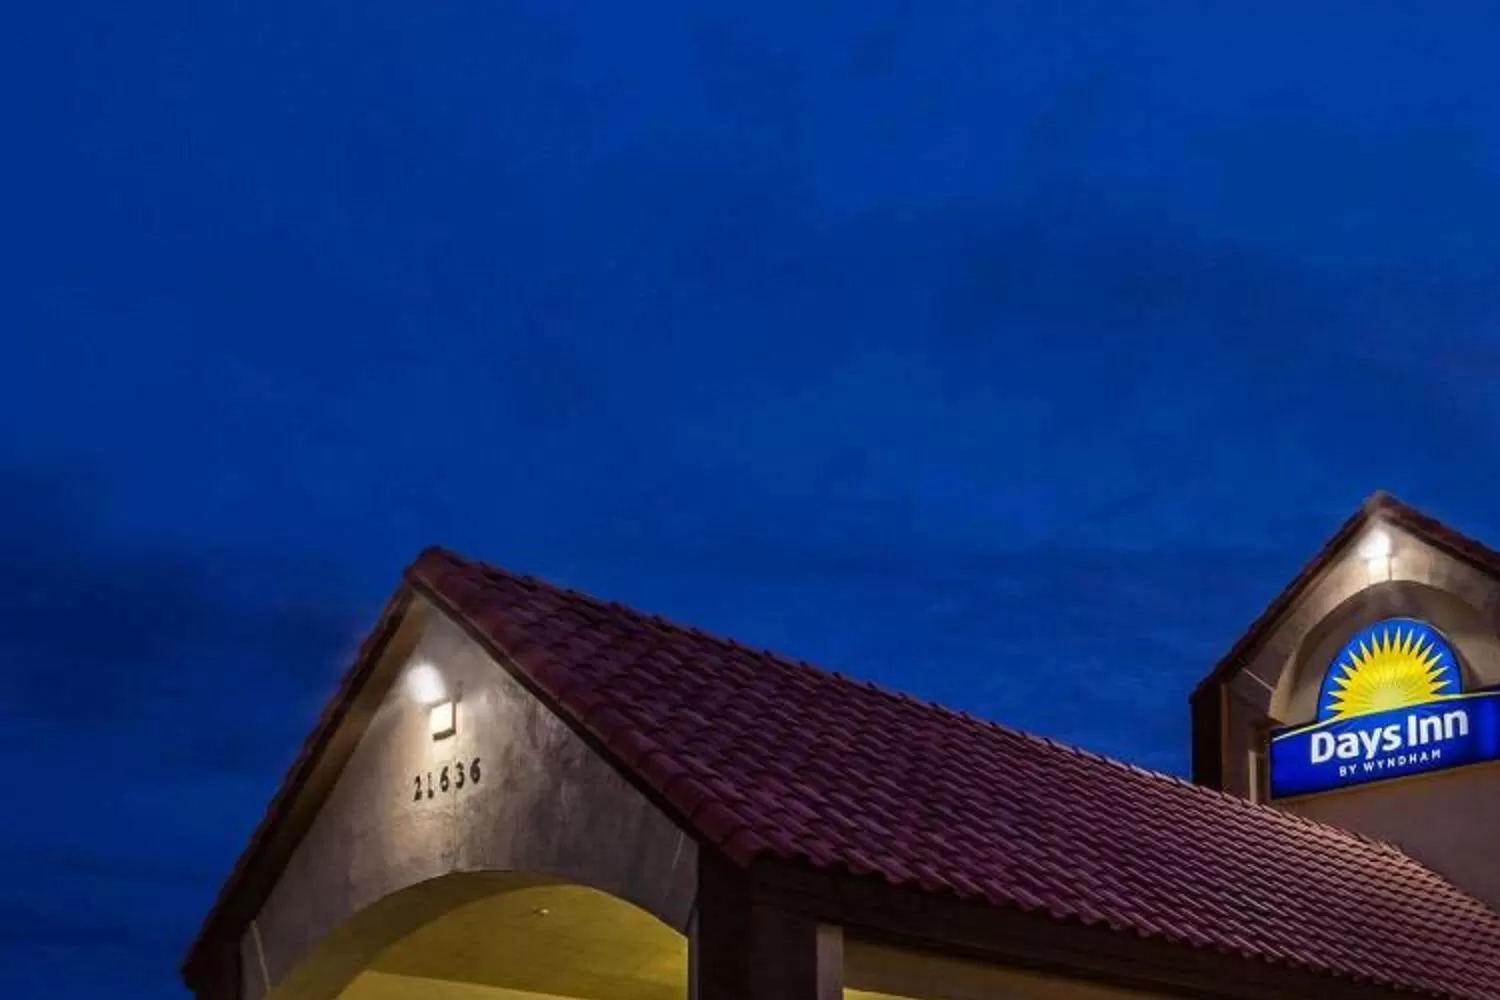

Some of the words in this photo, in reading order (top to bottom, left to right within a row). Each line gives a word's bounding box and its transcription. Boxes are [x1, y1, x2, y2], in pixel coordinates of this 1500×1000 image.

[1311, 725, 1402, 764] Days
[1407, 709, 1469, 747] Inn
[412, 757, 481, 801] 21636
[1339, 764, 1357, 777] BY
[1363, 749, 1441, 773] WYNDHAM
